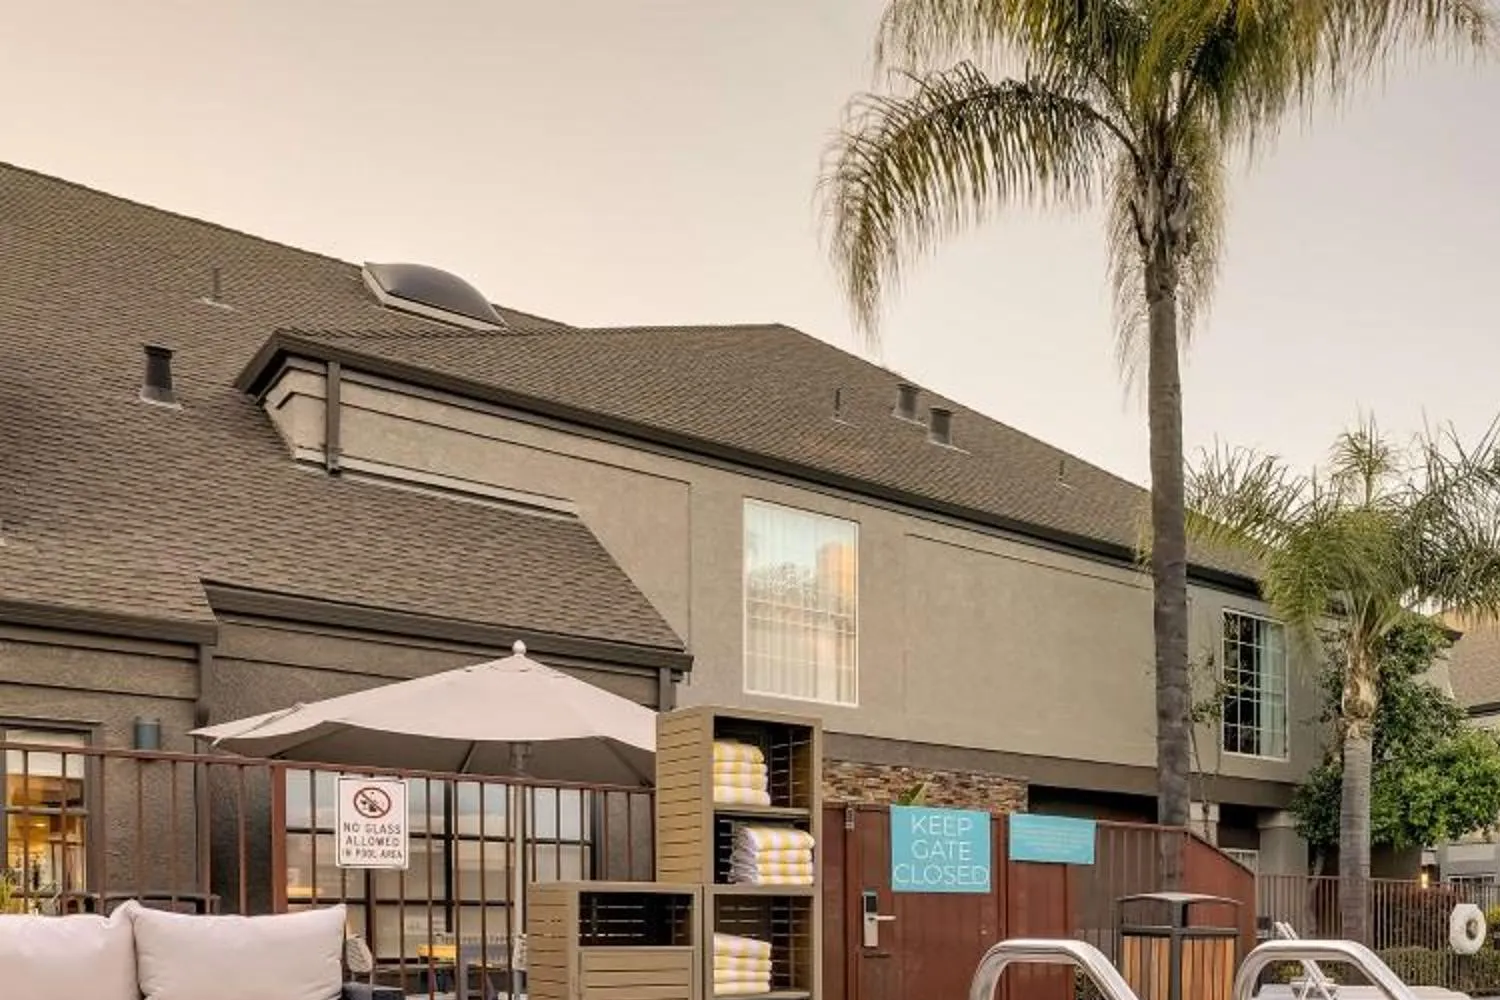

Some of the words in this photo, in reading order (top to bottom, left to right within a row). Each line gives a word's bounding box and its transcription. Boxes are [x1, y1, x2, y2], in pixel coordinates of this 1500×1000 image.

[343, 822, 360, 833] NO
[365, 823, 401, 835] GLASS
[911, 815, 973, 837] KEEP
[345, 836, 400, 847] ALLOWED
[911, 839, 973, 861] GATE
[893, 863, 990, 885] CLOSED
